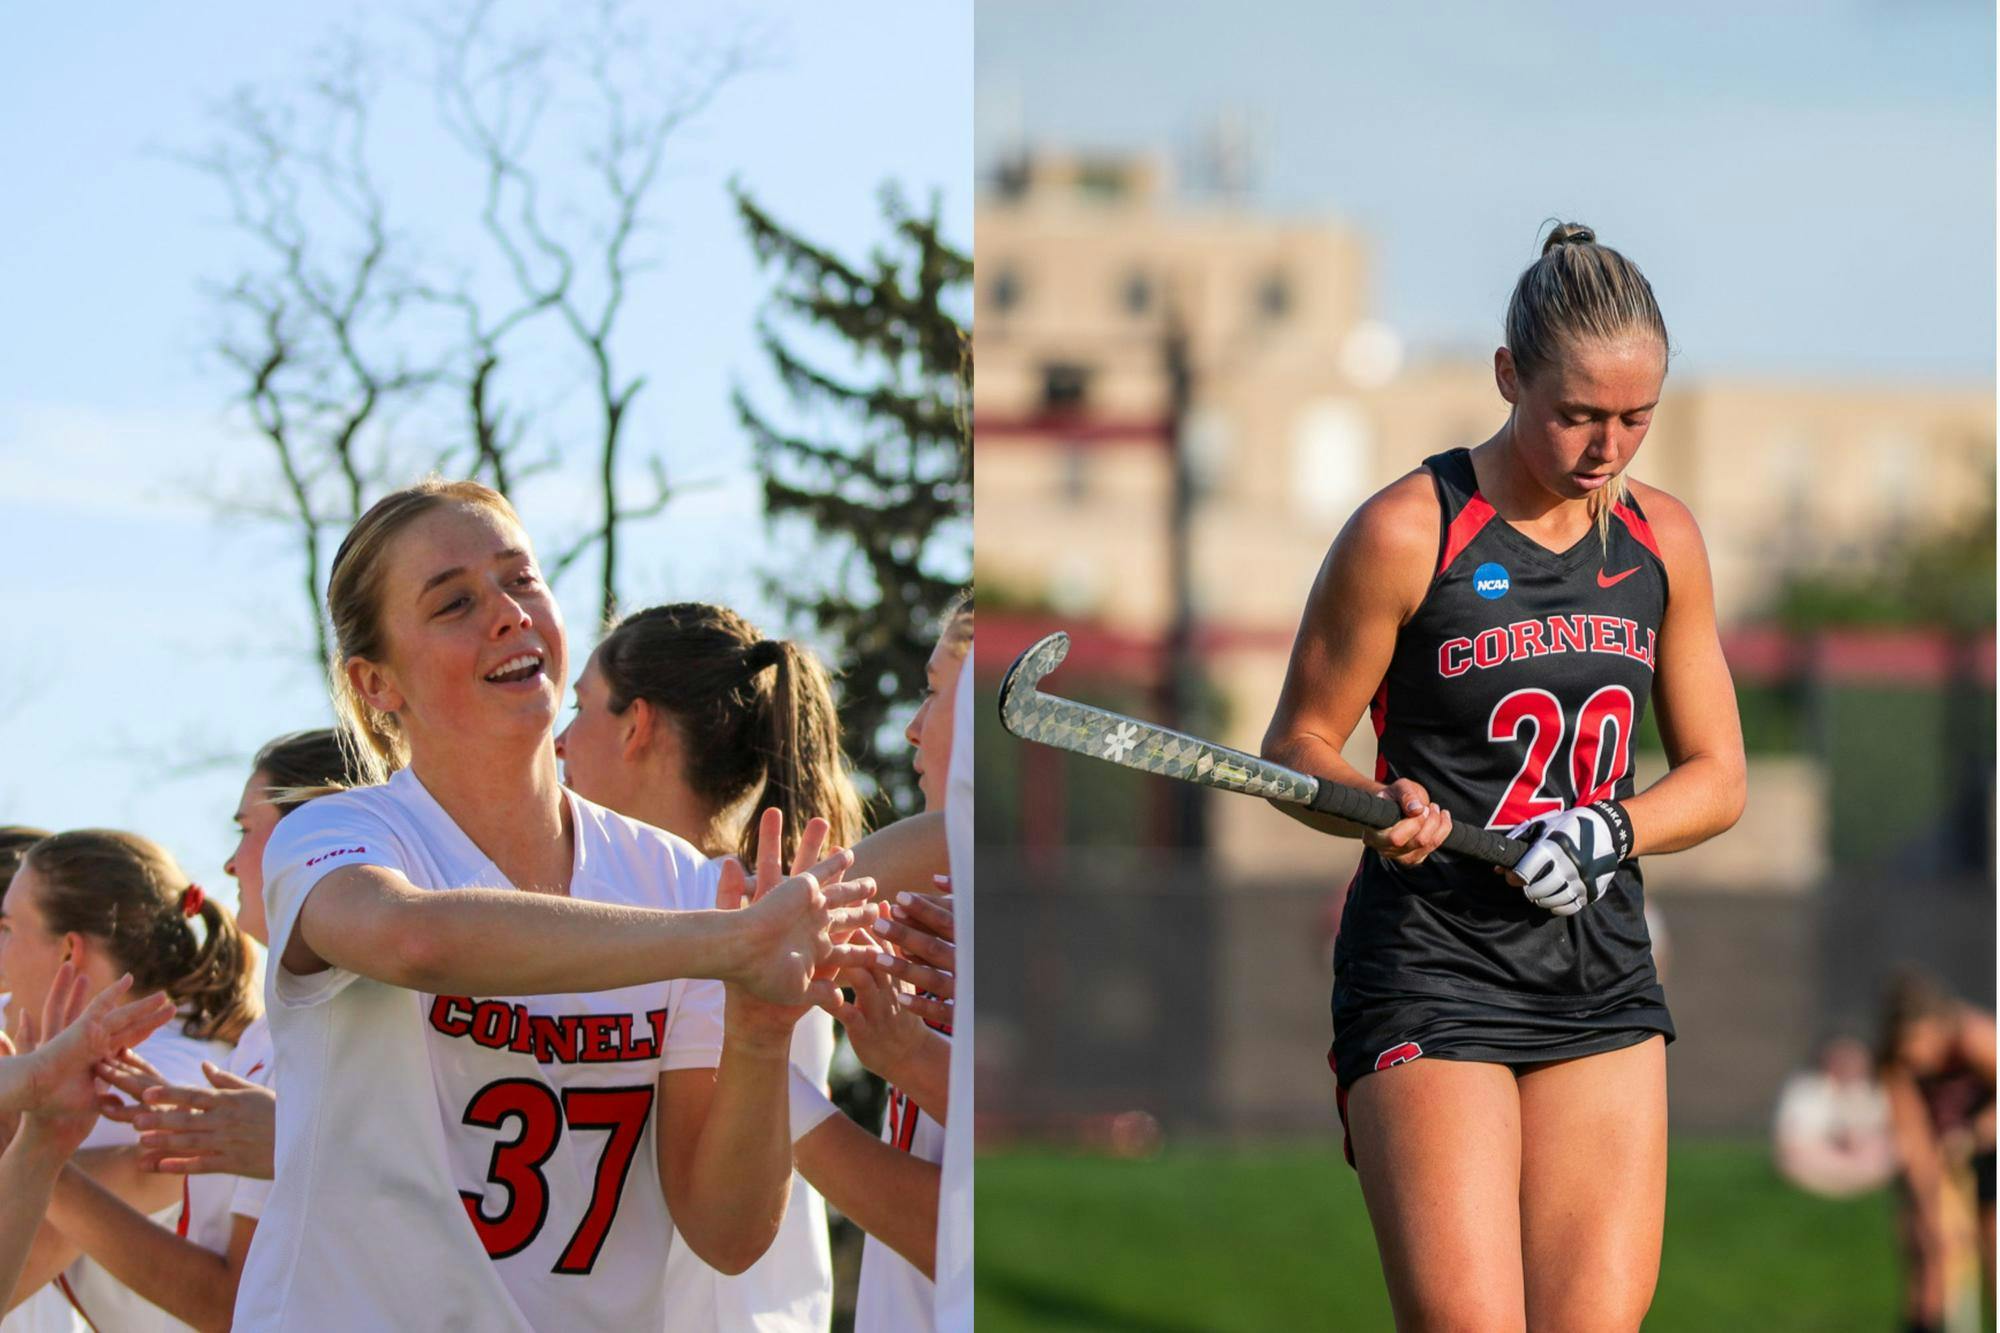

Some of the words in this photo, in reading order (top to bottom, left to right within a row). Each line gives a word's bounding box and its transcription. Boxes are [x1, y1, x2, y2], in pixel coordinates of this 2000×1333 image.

[1477, 579, 1509, 591] NCAA
[1485, 684, 1634, 830] 20
[458, 1077, 655, 1275] 37
